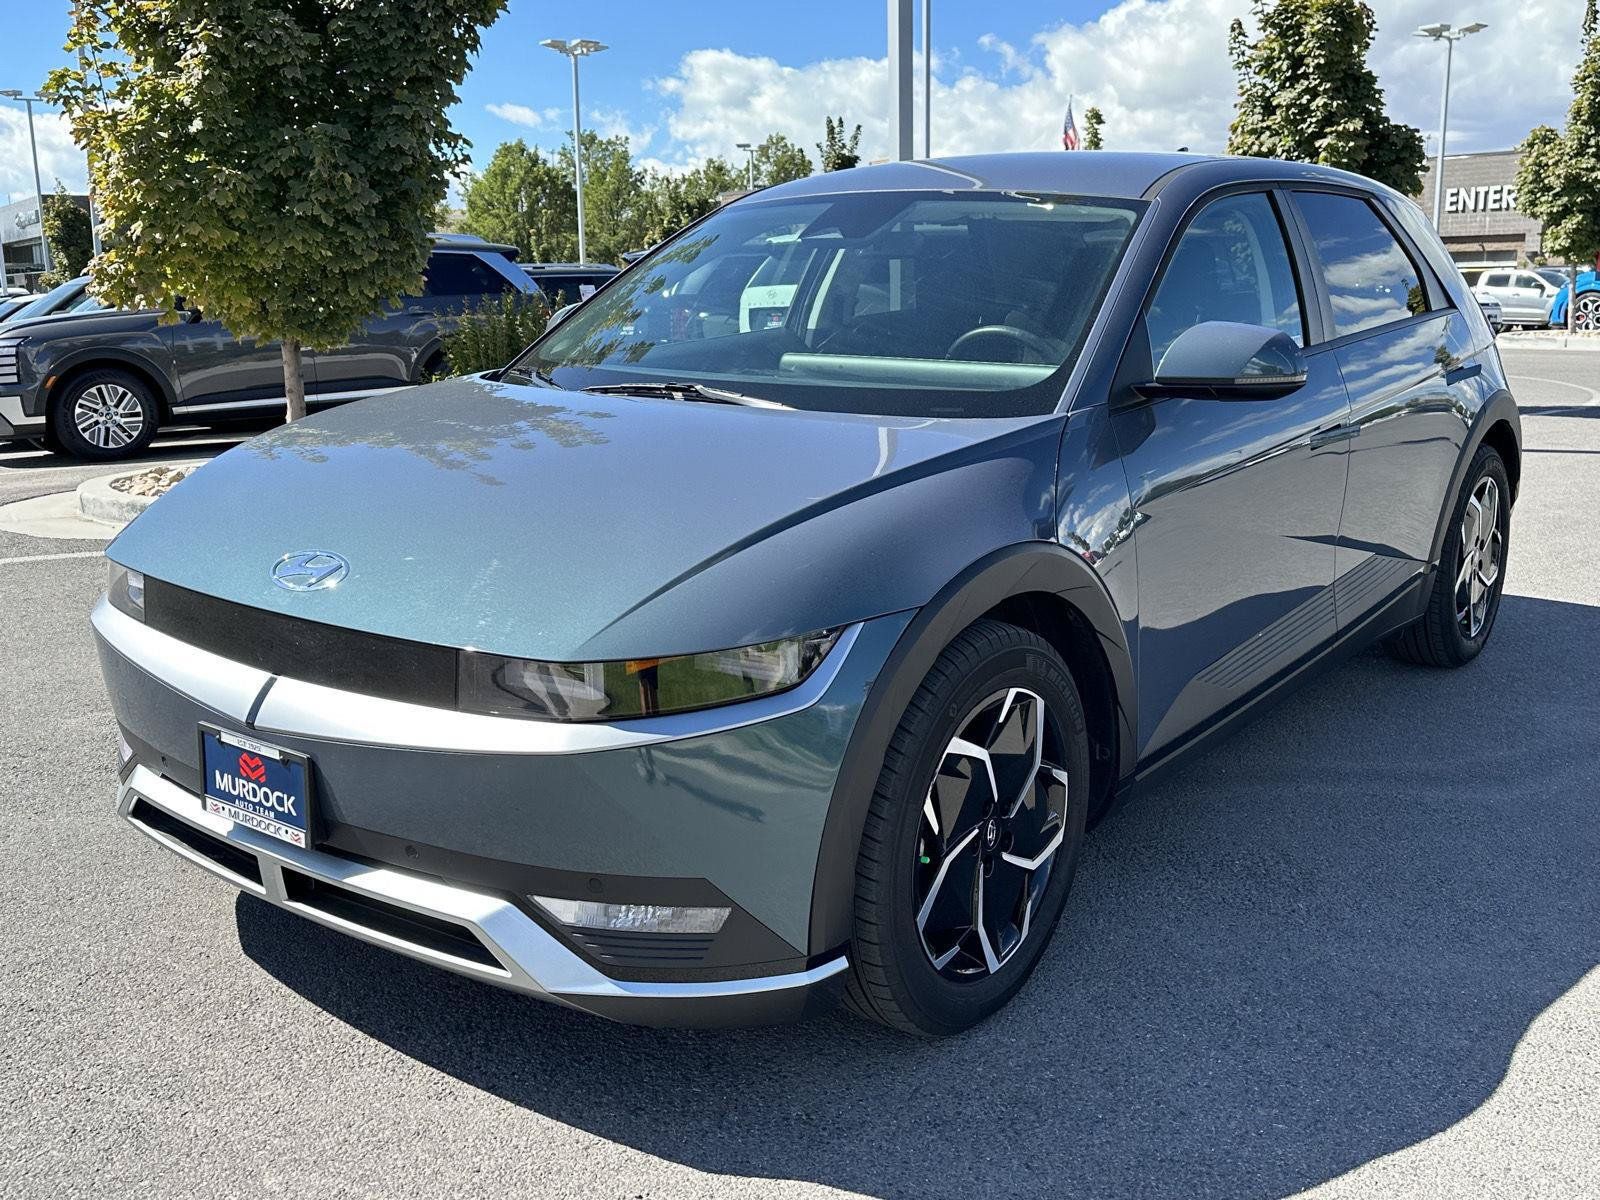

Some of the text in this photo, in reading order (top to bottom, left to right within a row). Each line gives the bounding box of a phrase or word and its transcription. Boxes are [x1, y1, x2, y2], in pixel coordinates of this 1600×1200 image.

[215, 770, 297, 816] MURDOCK
[228, 808, 281, 836] MURDOCK
[234, 799, 275, 819] AUTO TEAM
